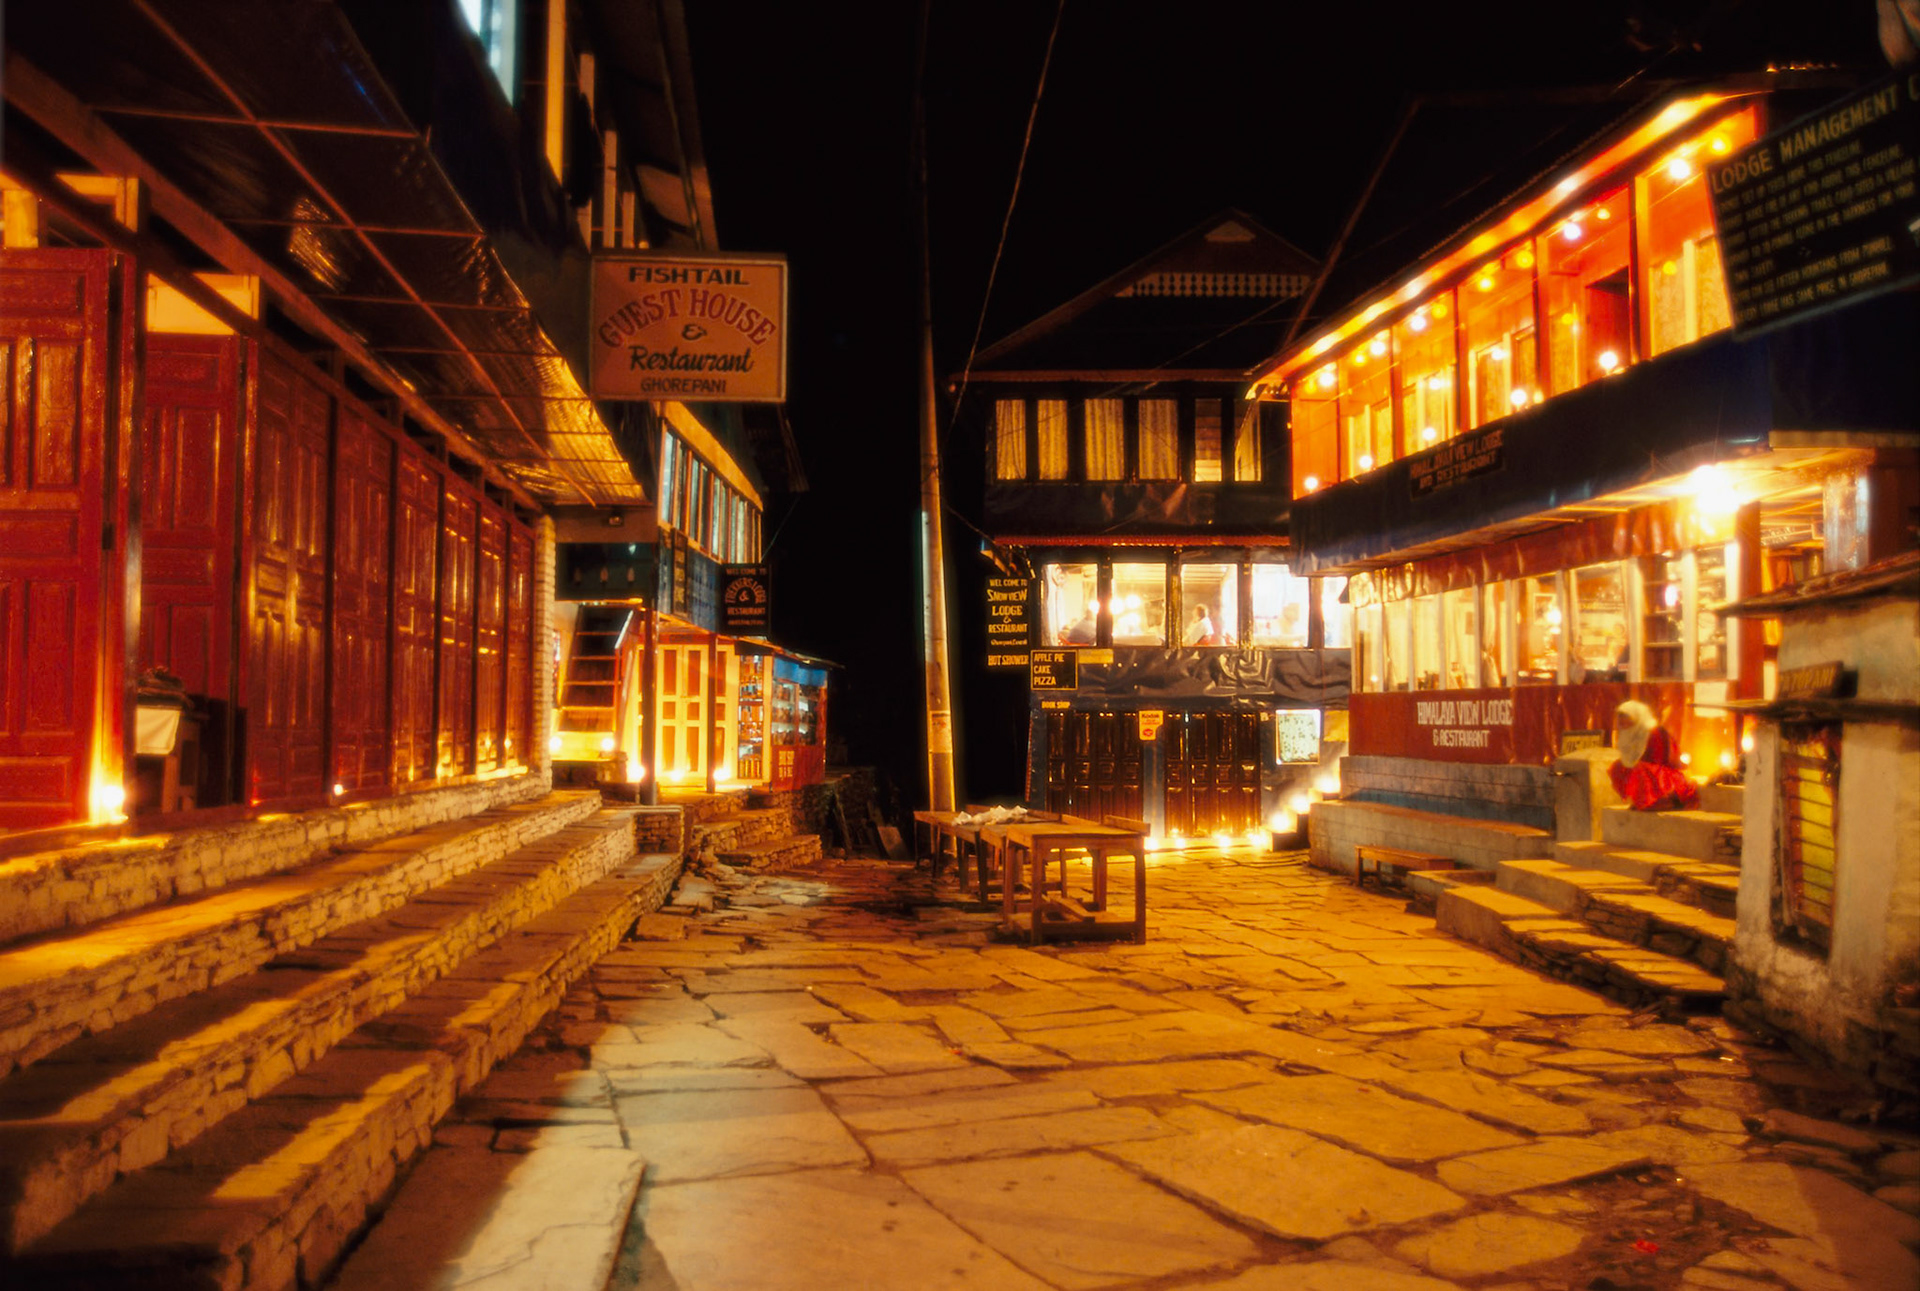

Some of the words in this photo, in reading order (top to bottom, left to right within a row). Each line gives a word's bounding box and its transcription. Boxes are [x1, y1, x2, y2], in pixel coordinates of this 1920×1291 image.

[1711, 148, 1772, 195] LODGE
[1780, 83, 1898, 163] MANAGEMENT
[628, 267, 749, 285] FISHTAIL
[598, 289, 681, 348] GUEST
[689, 288, 776, 345] HOUSE
[681, 323, 707, 340] &
[628, 345, 755, 373] Restaurant
[640, 377, 726, 393] GHOREPANI
[992, 605, 1023, 616] LODGE
[1003, 615, 1012, 623] &
[988, 624, 1028, 633] RESTAURANT
[1034, 653, 1053, 662] APPLE
[1055, 653, 1065, 662] PIE
[1034, 665, 1051, 674] CAKE
[1034, 676, 1056, 685] PIZZA
[1457, 701, 1479, 725] VIEW
[1481, 700, 1513, 725] LODGE
[1440, 729, 1490, 747] RESTAURANT
